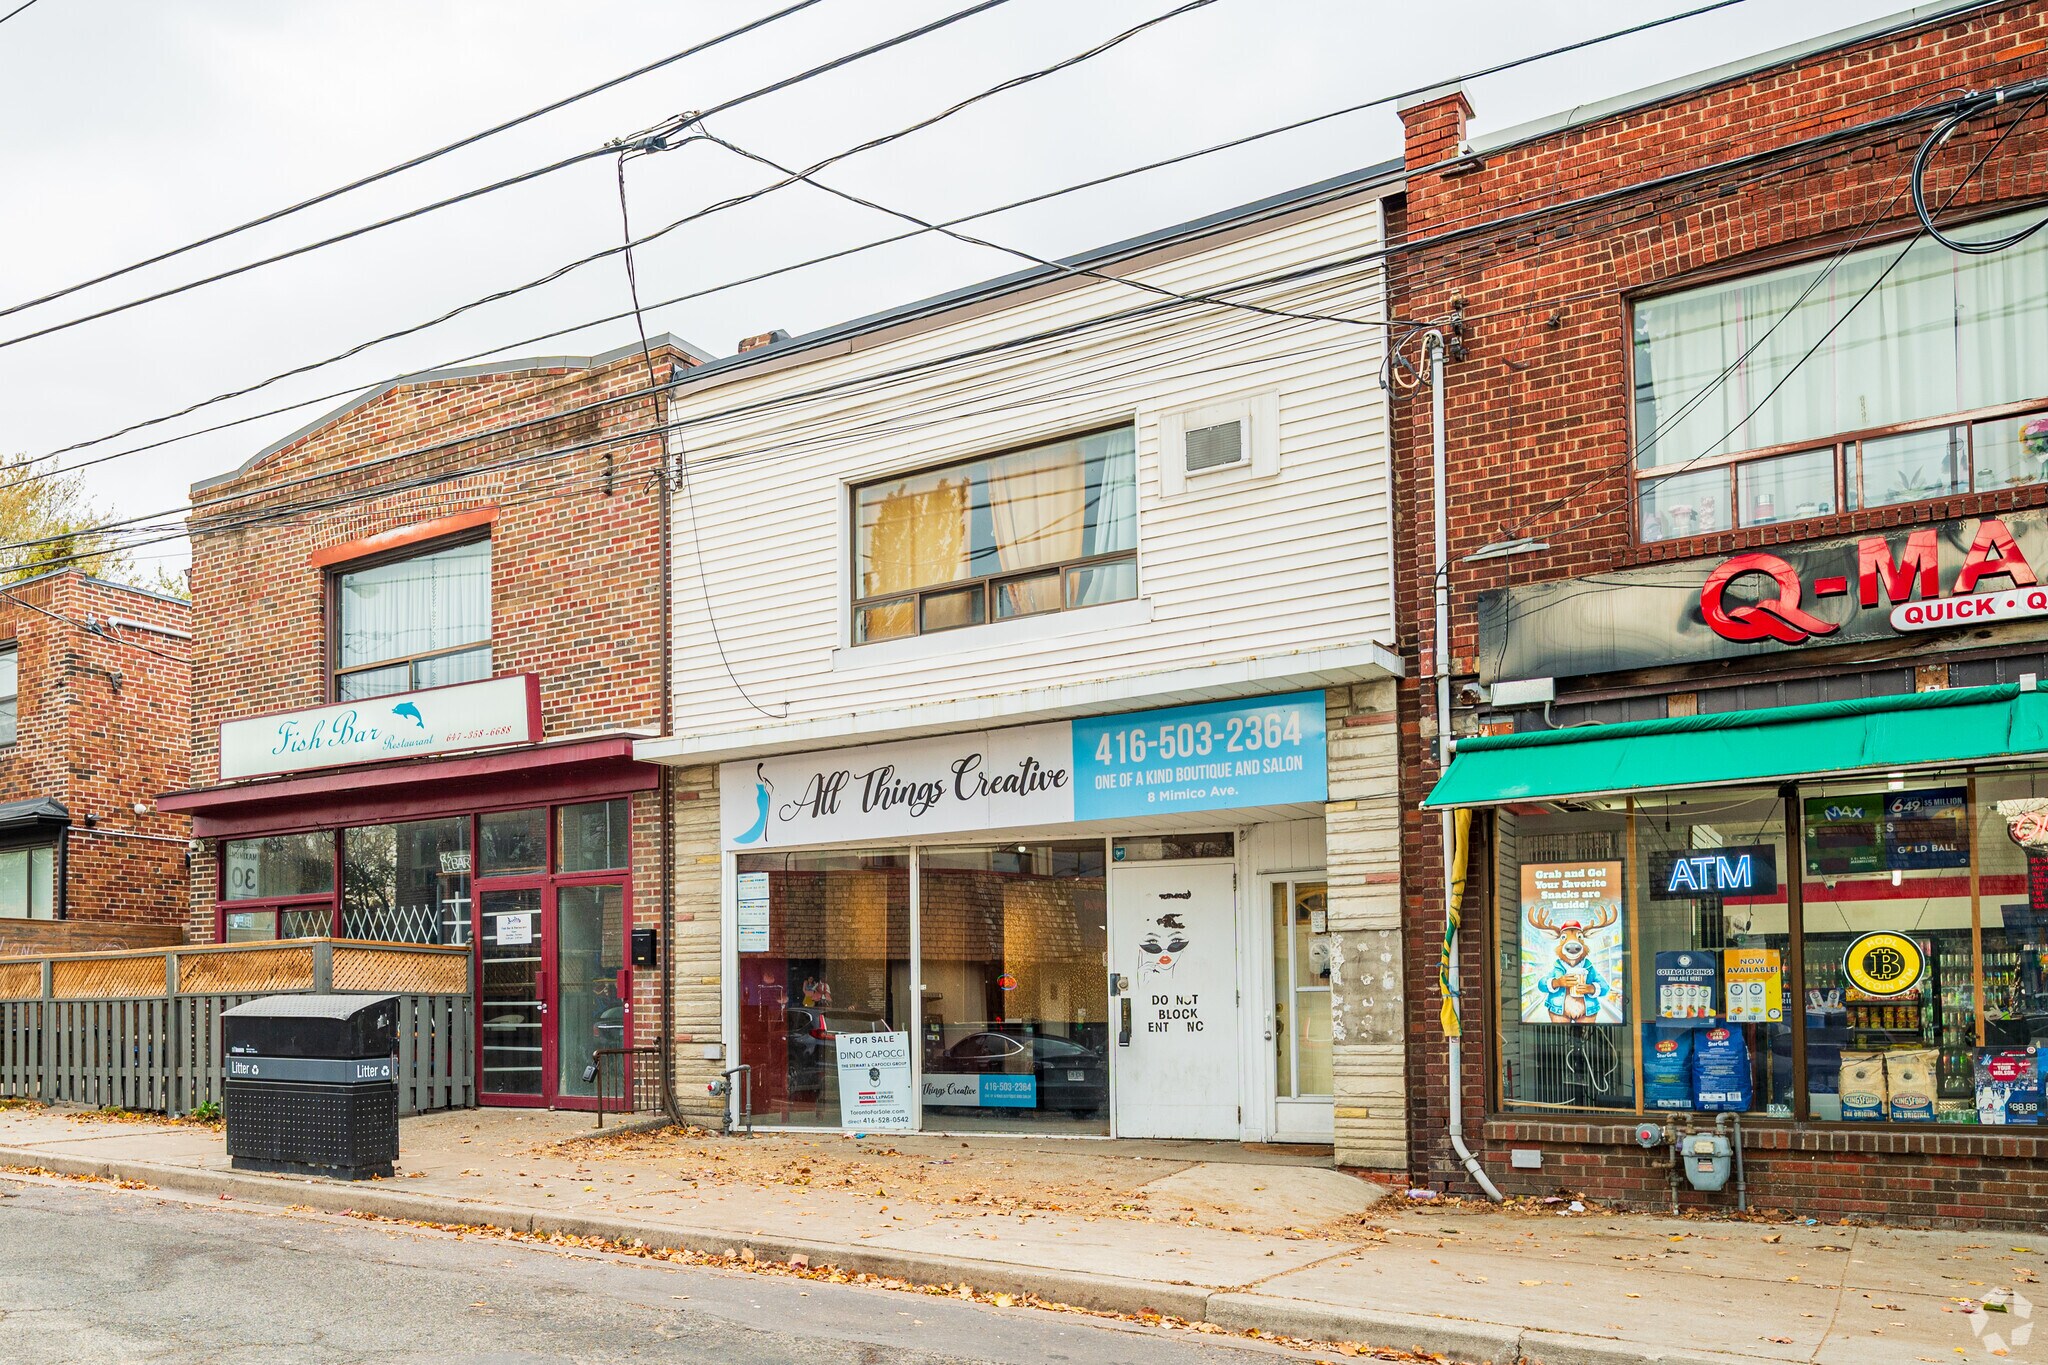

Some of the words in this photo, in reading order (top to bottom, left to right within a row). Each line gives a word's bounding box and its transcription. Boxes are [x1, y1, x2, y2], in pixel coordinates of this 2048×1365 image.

[1905, 598, 1996, 625] QUICK
[272, 720, 325, 754] Fish
[329, 710, 382, 747] Bar
[382, 734, 434, 750] Restaurant
[446, 725, 512, 742] 647-358-6688
[1095, 710, 1303, 765] 416-503-2364
[1095, 773, 1116, 790] ONE
[1119, 772, 1133, 787] OF
[1135, 771, 1144, 786] A
[1146, 768, 1173, 785] KIND
[1176, 762, 1232, 783] BOUTIQUE
[1235, 759, 1260, 778] AND
[1263, 755, 1303, 774] SALON
[779, 770, 849, 821] All
[853, 764, 947, 818] Things
[951, 753, 1069, 801] Creative
[1147, 791, 1155, 802] 8
[1159, 788, 1206, 802] Mimico
[1210, 785, 1239, 797] Ave.
[1933, 797, 1963, 806] MILLION
[1824, 806, 1863, 821] MAX
[1931, 844, 1957, 852] BALL
[1535, 870, 1561, 879] Grab
[1564, 869, 1585, 878] and
[1587, 868, 1606, 878] Go!
[1668, 854, 1751, 891] ATM
[1535, 880, 1559, 889] Your
[1562, 879, 1607, 888] Favorite
[1541, 890, 1580, 899] Snacks
[1552, 900, 1589, 909] Inside!
[1866, 937, 1897, 947] HODL
[1656, 968, 1685, 976] COTTAGE
[1686, 968, 1714, 976] SPRINGS
[1853, 969, 1895, 990] BITCOIN
[1897, 967, 1916, 987] ATM
[1152, 995, 1168, 1006] DO
[1158, 1008, 1198, 1020] BLOCK
[840, 1051, 863, 1060] DINO
[865, 1049, 905, 1059] CAPOCCI
[231, 1061, 250, 1074] Litter
[357, 1065, 378, 1077] Litter
[947, 1082, 977, 1096] Creative
[984, 1082, 1032, 1092] 416-503-2364
